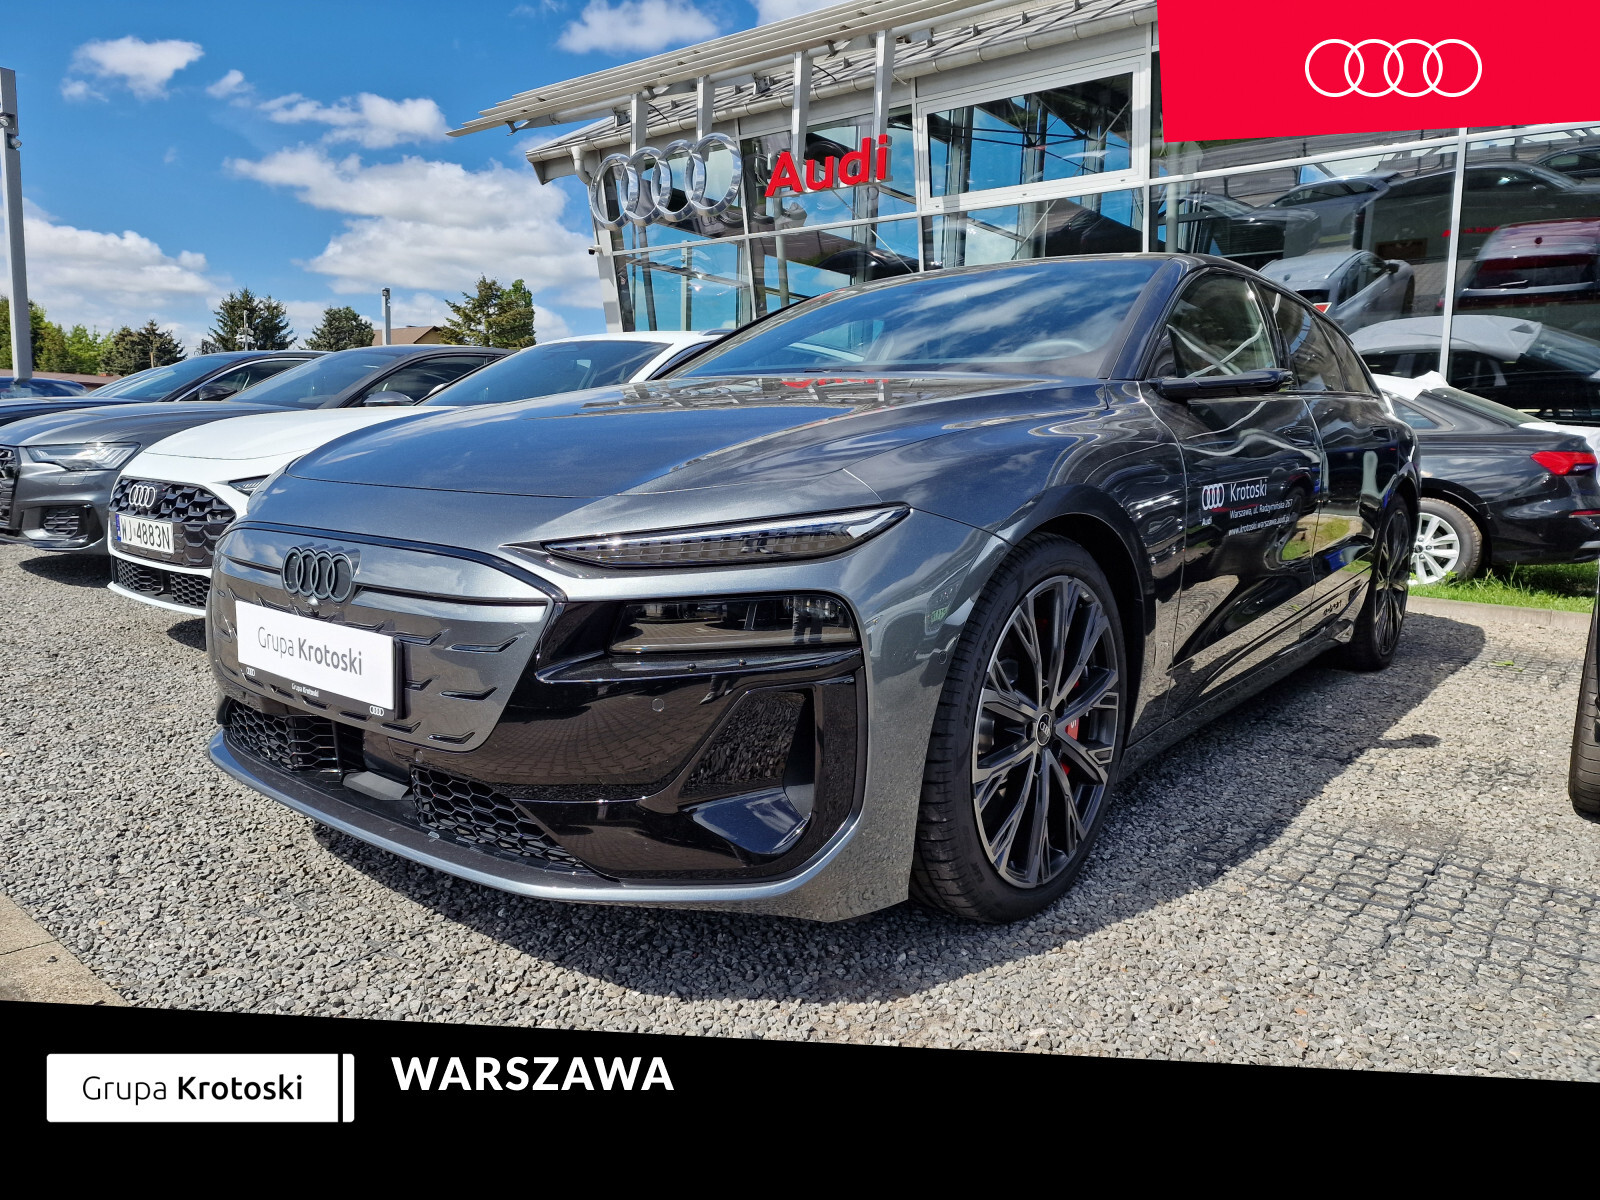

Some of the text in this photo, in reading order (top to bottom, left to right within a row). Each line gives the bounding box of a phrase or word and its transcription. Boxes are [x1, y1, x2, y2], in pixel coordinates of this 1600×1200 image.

[764, 134, 893, 198] Audi
[1230, 479, 1267, 502] Krotoski
[120, 516, 170, 550] WJ 4883N
[1201, 516, 1212, 526] Audi
[257, 626, 362, 676] Grupa Krotoski
